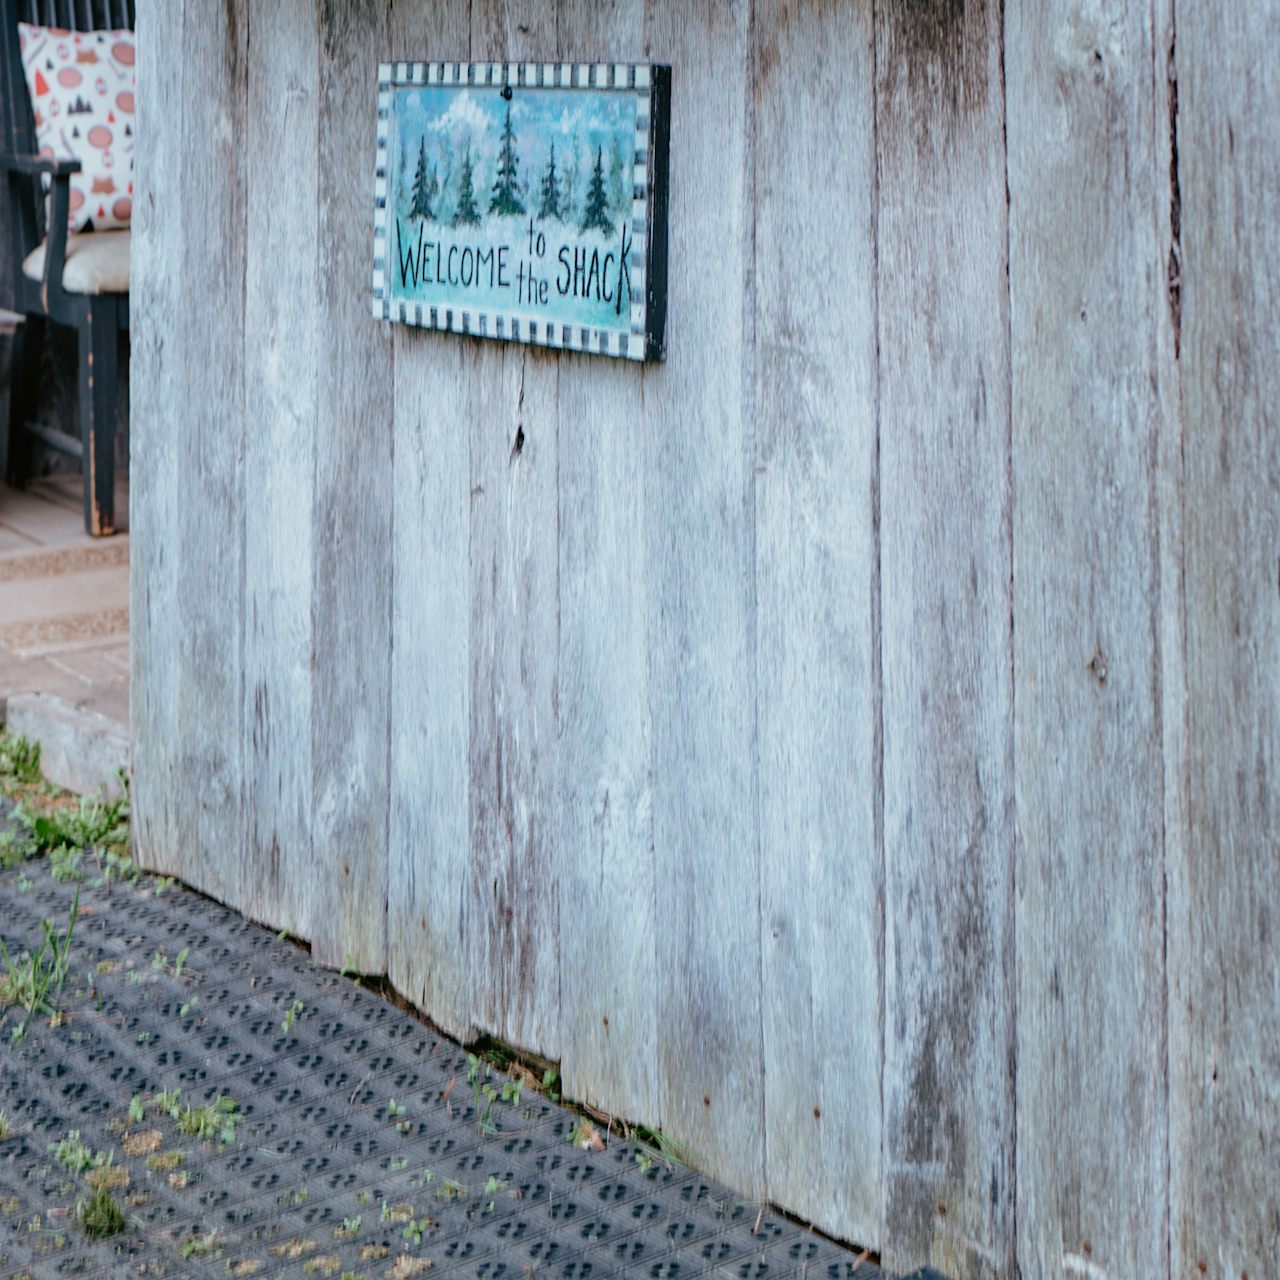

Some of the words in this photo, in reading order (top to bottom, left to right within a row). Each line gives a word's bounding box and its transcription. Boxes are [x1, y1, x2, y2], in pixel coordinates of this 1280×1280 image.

[396, 217, 511, 289] WELCOME
[527, 217, 546, 257] to
[516, 260, 549, 305] the
[556, 222, 633, 315] SHACK
